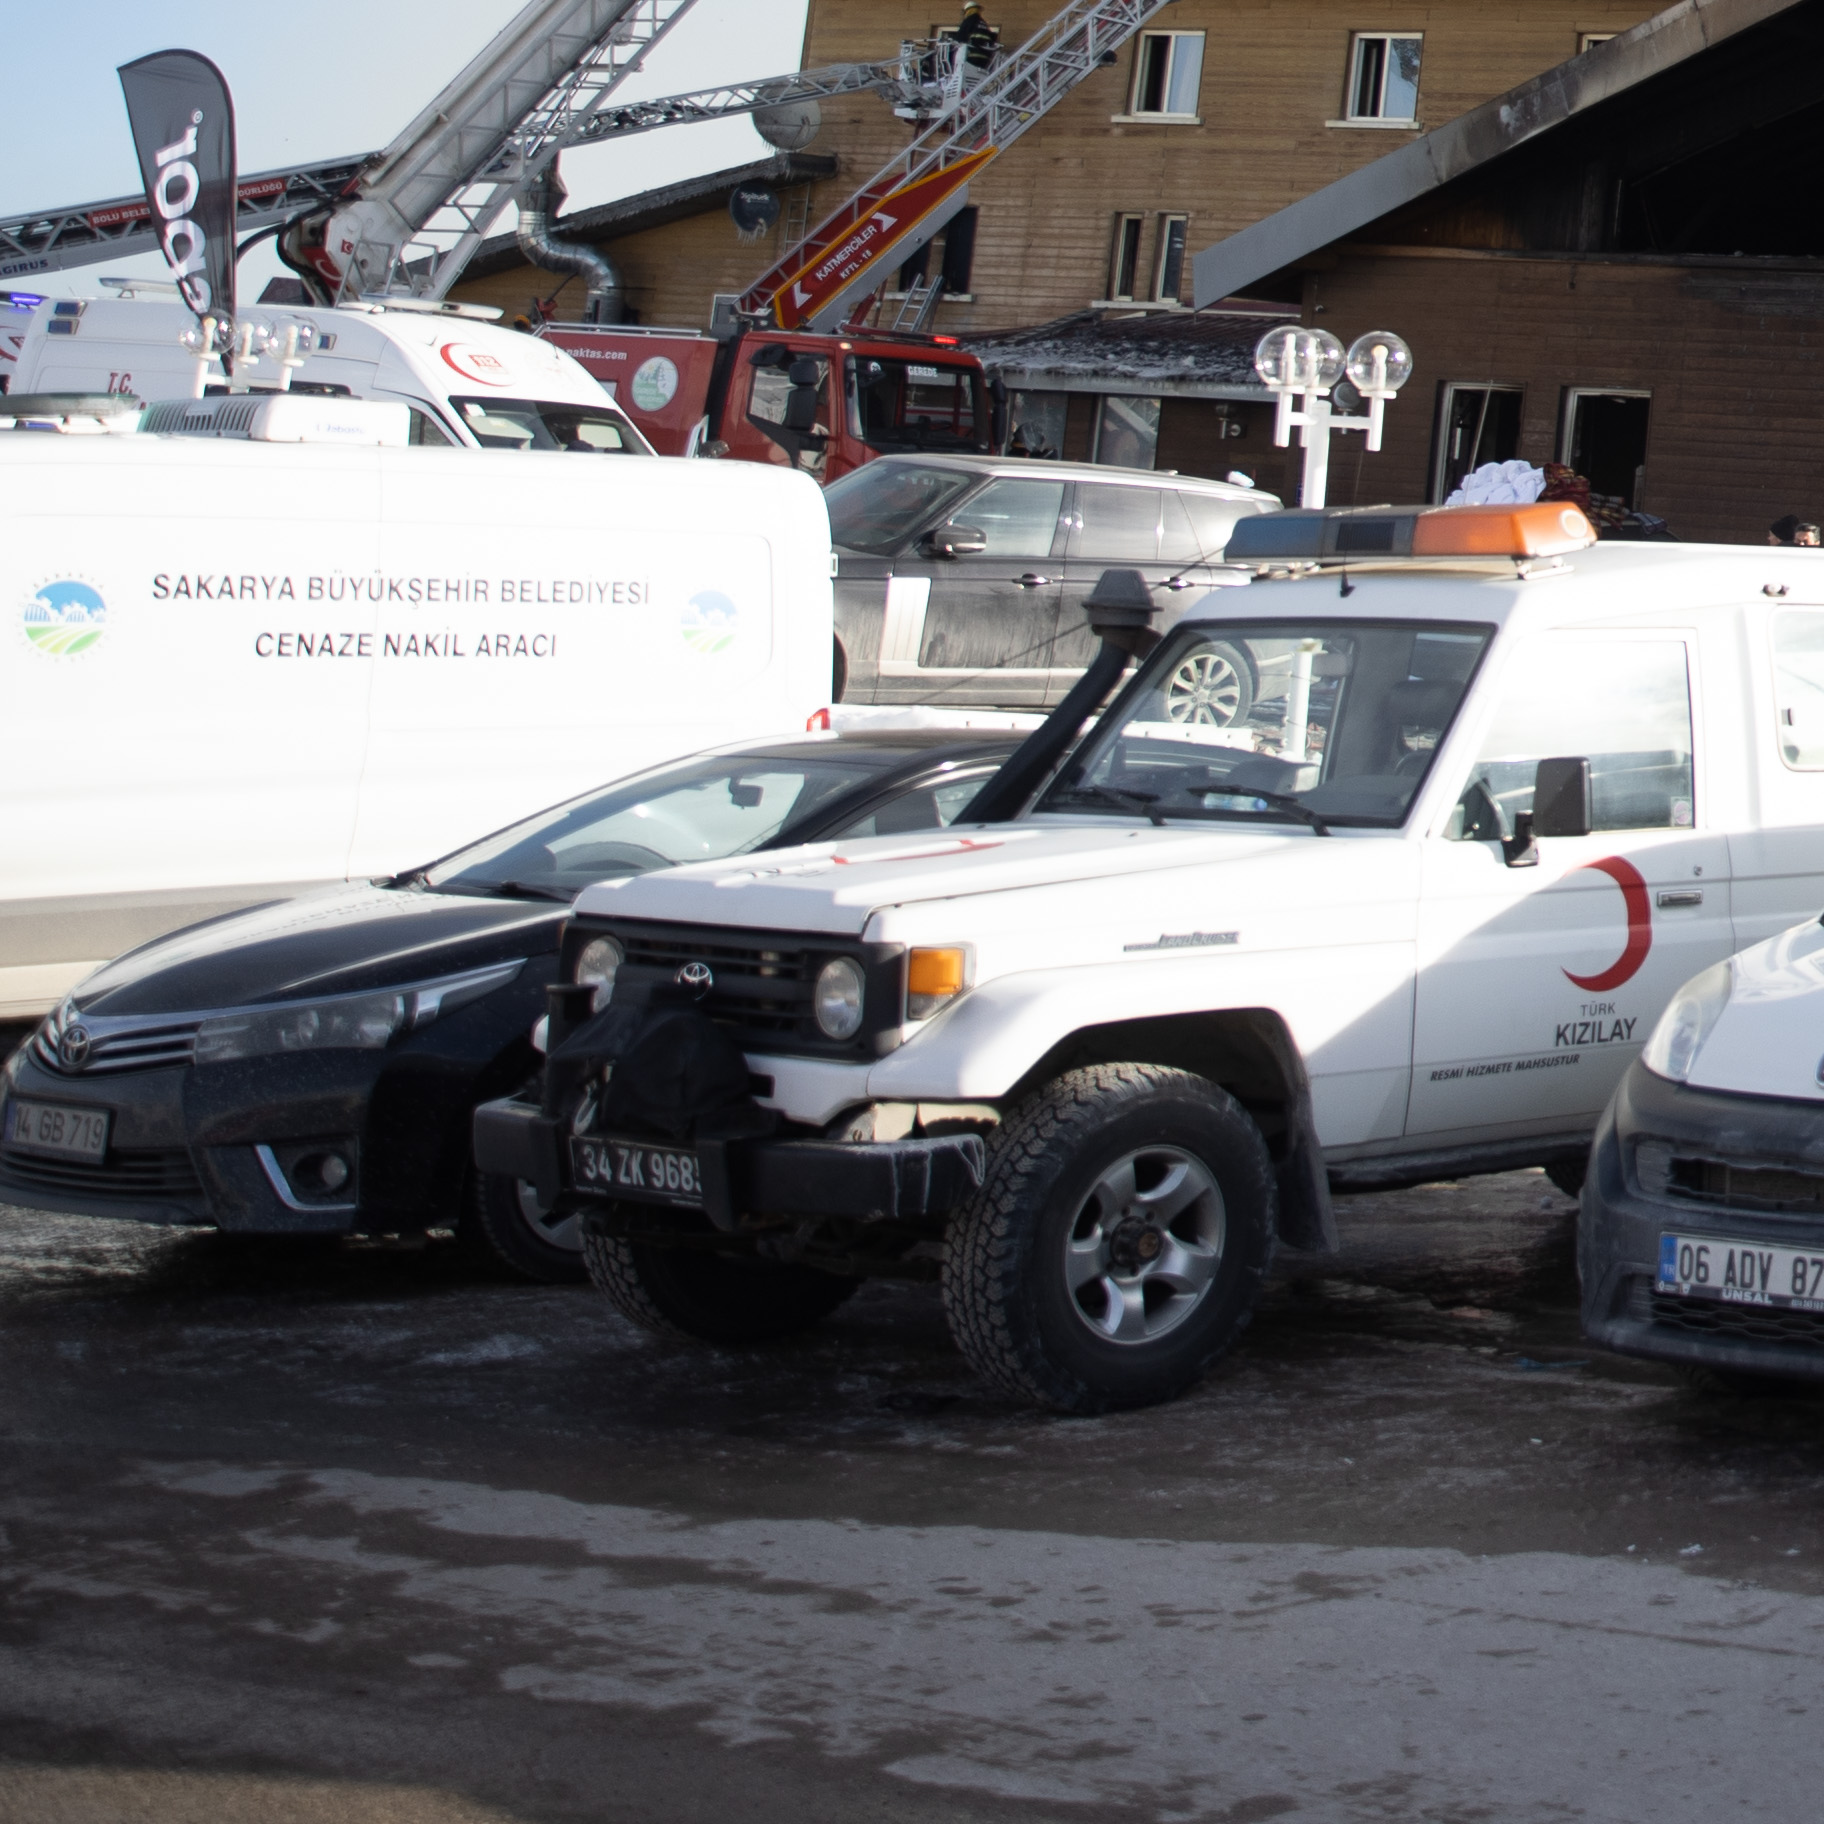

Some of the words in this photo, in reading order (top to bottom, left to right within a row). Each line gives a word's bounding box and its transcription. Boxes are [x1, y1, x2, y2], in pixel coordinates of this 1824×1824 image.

[92, 212, 119, 225] BOLU
[814, 224, 878, 281] KATMERCİLER
[107, 372, 132, 394] T.C.
[152, 573, 296, 601] SAKARYA
[307, 569, 490, 610] BÜYÜKŞEHİR
[501, 574, 650, 605] BELEDİYESİ
[255, 632, 374, 658] CENAZE
[383, 626, 467, 657] NAKİL
[475, 633, 557, 657] ARACI
[1580, 1001, 1616, 1017] TÜRK
[1555, 1017, 1638, 1048] KIZILAY
[1430, 1064, 1465, 1082] RESMİ
[1466, 1061, 1513, 1078] HİZMETE
[1514, 1053, 1581, 1072] MAHSUSTUR
[68, 1113, 105, 1150] 719
[583, 1144, 613, 1182] 34
[618, 1147, 646, 1187] ZK
[1679, 1242, 1711, 1284] 06
[1724, 1248, 1774, 1292] ADV
